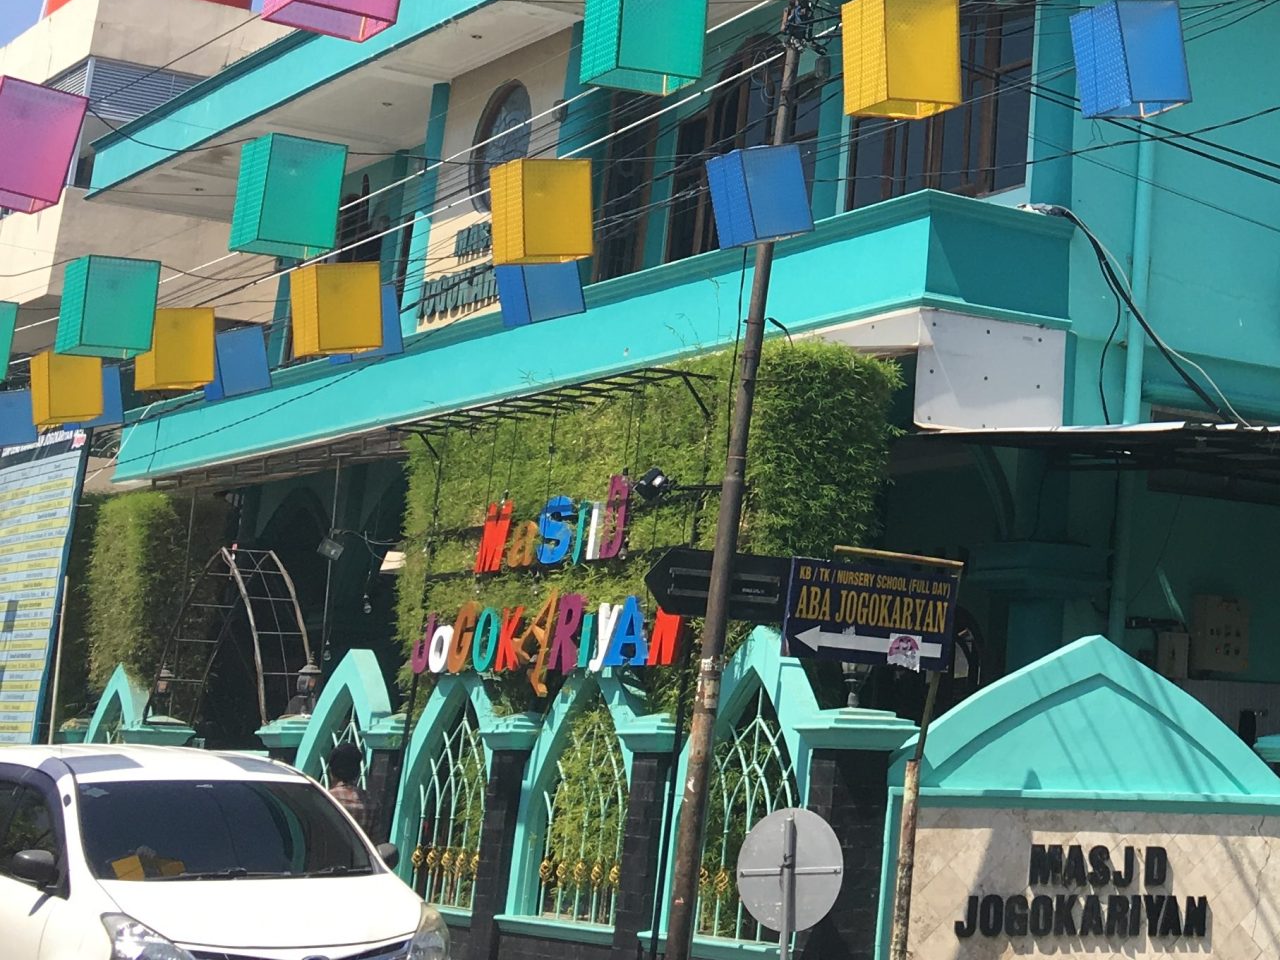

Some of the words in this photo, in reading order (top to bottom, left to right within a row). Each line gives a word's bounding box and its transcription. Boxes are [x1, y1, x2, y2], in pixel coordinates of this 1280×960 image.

[799, 566, 812, 580] KB
[819, 567, 830, 583] TK
[837, 570, 875, 587] NURSERY
[876, 574, 907, 591] SCHOOL
[908, 579, 930, 595] (FULL
[932, 581, 951, 599] DAY)
[795, 585, 831, 621] ABA
[835, 590, 949, 634] JOGOKARYAN
[954, 894, 1208, 939] JOGOKARIYAN
